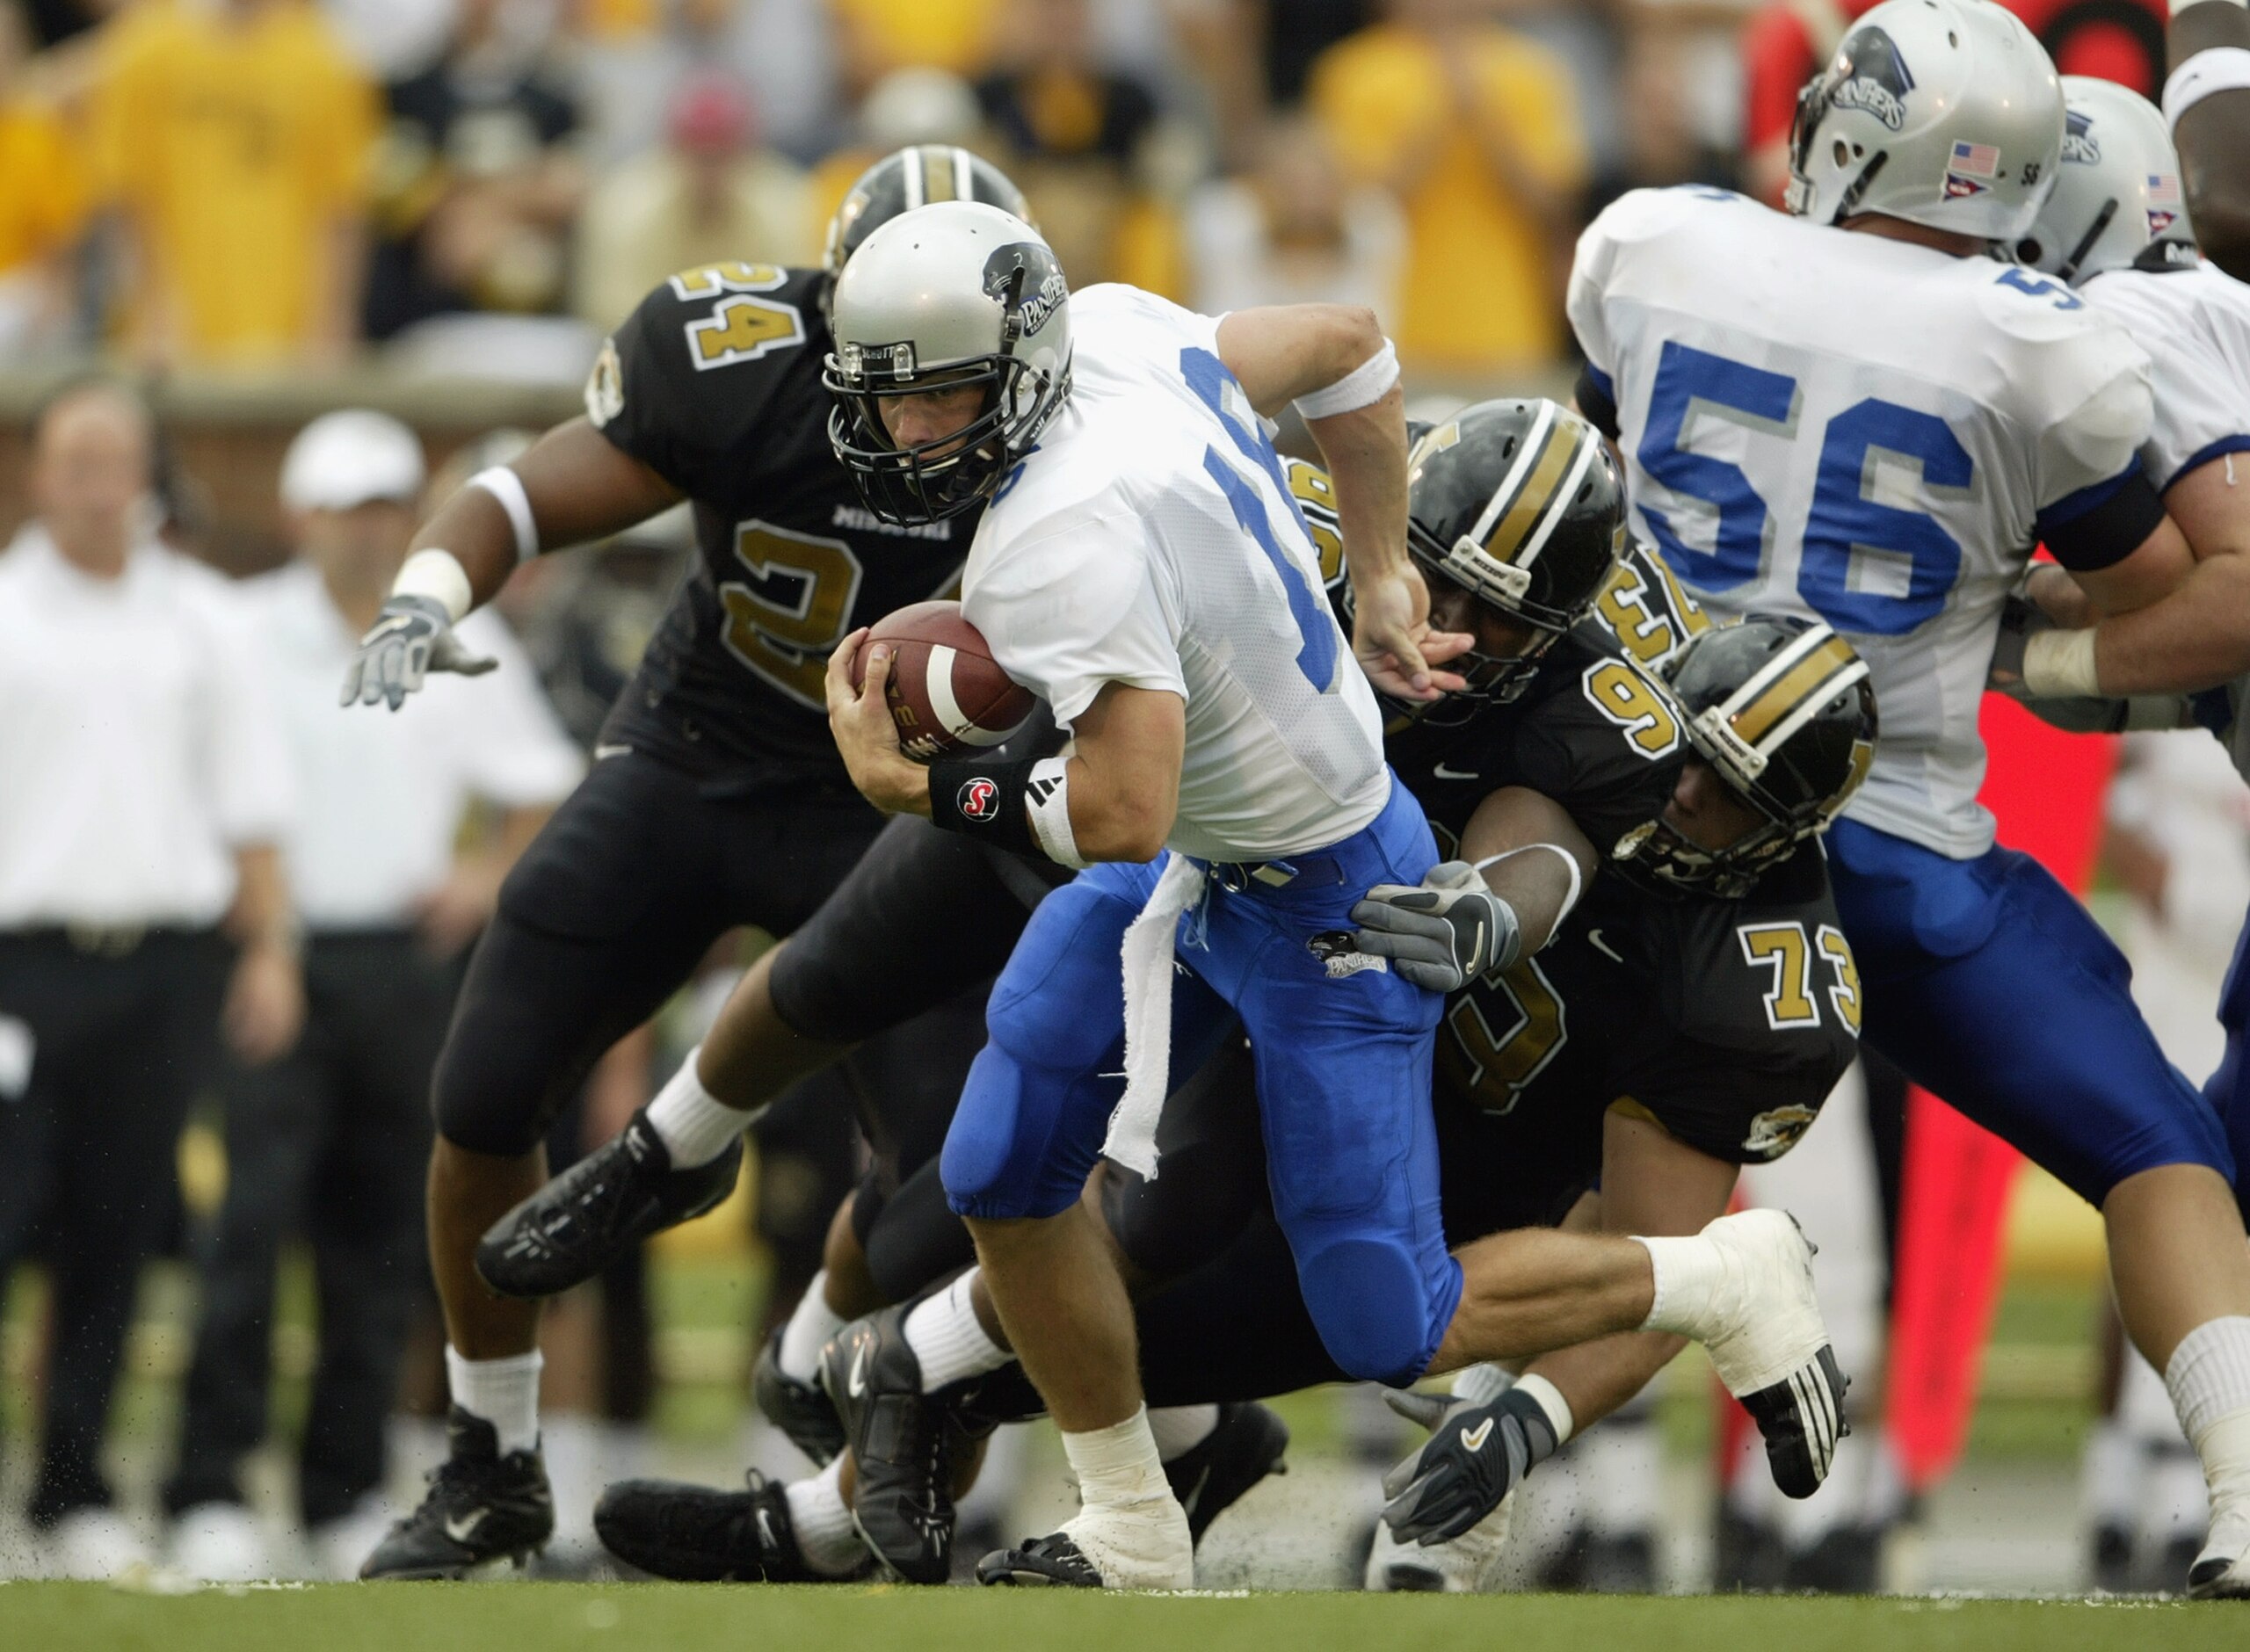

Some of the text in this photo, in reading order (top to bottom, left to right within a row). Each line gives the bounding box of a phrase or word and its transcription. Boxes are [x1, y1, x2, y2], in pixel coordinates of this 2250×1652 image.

[1834, 76, 1901, 127] ANTHERS
[667, 261, 807, 372] 24
[1993, 268, 2082, 310] 5
[1636, 339, 1982, 638] 56
[1583, 648, 1692, 762] 9
[1737, 920, 1862, 1040] 73
